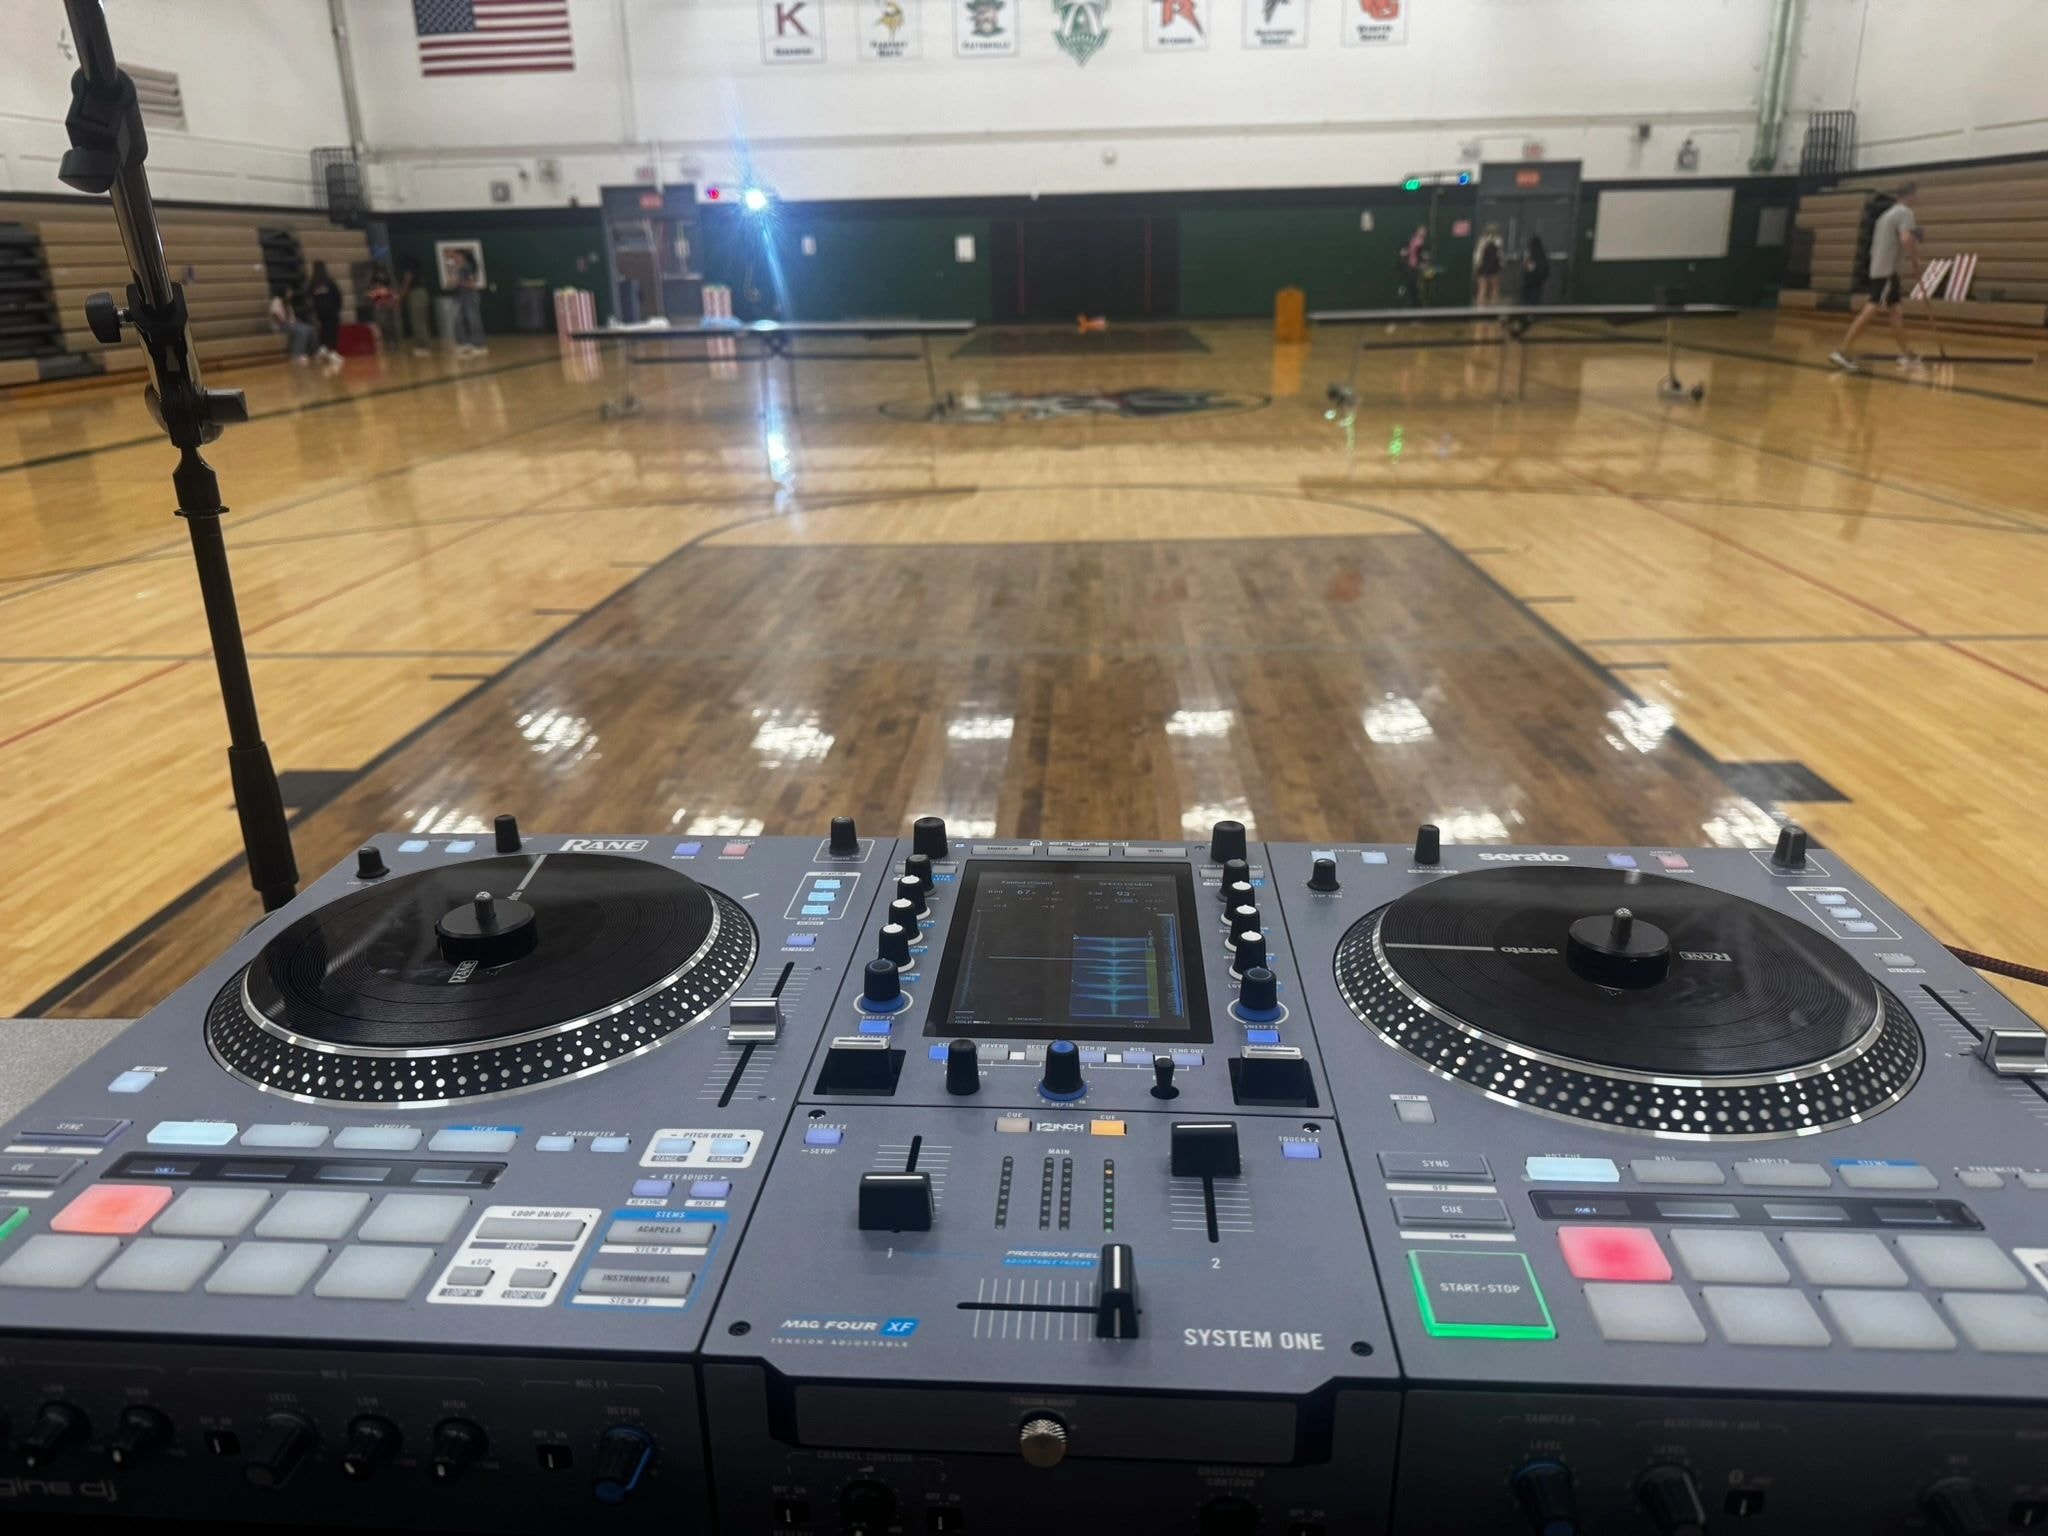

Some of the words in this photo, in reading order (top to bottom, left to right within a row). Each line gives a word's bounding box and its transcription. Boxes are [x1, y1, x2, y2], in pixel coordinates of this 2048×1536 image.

[774, 1, 808, 36] K
[559, 839, 649, 851] RANE
[1478, 852, 1570, 862] serato
[1500, 946, 1558, 955] serato
[1679, 951, 1733, 962] RANE
[57, 1123, 83, 1131] SYNC
[1422, 1160, 1450, 1168] SYNC
[1441, 1205, 1464, 1213] CUE
[634, 1246, 658, 1254] STEM
[1006, 1250, 1069, 1258] PRECISION
[471, 1258, 493, 1266] x1/2
[535, 1260, 549, 1268] x2
[1211, 1257, 1222, 1269] 2
[602, 1274, 671, 1284] INSTRUMENTAL
[781, 1319, 820, 1329] MAG
[823, 1320, 878, 1331] FOUR
[887, 1322, 914, 1332] XF
[770, 1337, 824, 1345] TENSION
[831, 1339, 909, 1348] ADJUSTABLE
[1183, 1328, 1273, 1348] SYSTEM
[1280, 1331, 1325, 1351] ONE
[607, 1406, 641, 1416] DEPTH
[1524, 1413, 1577, 1425] SAMPLER
[1530, 1439, 1563, 1450] LEVEL
